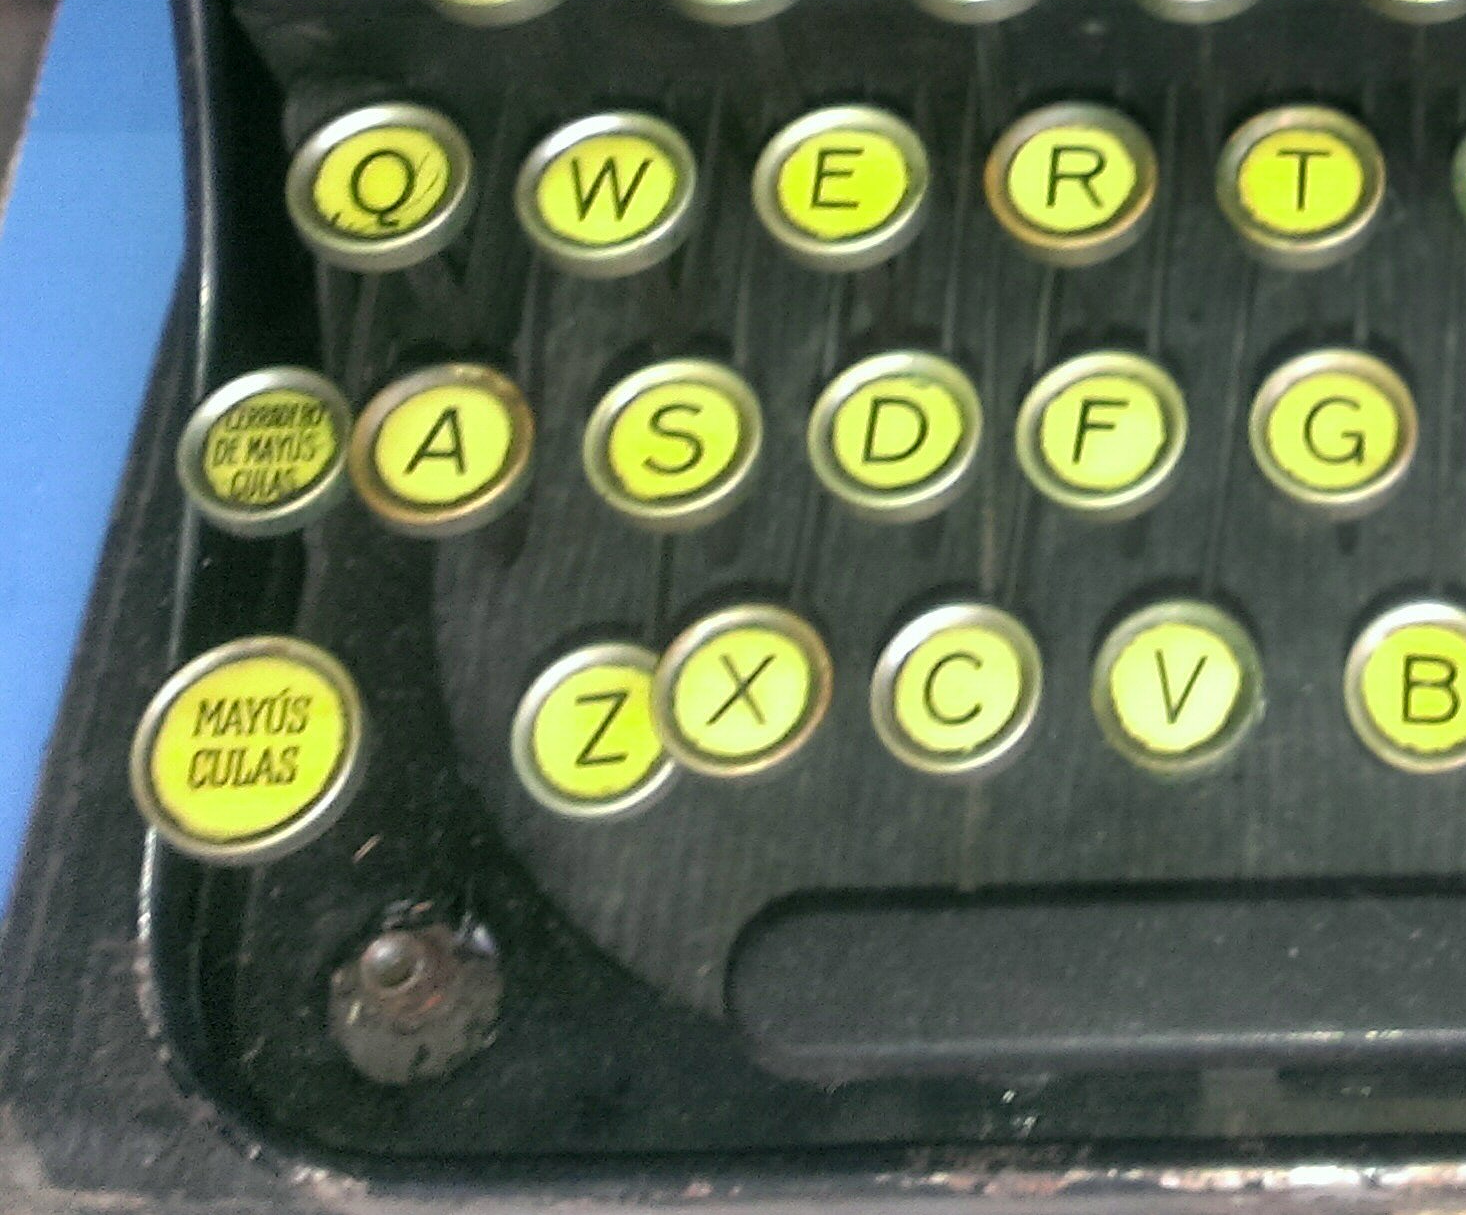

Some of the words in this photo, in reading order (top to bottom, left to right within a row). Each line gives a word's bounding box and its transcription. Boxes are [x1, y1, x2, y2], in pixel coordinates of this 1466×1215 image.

[350, 149, 416, 227] Q
[571, 156, 655, 223] W
[809, 147, 866, 210] E
[1045, 145, 1106, 209] R
[1277, 147, 1332, 212] T
[403, 405, 467, 475] A
[642, 402, 704, 476] S
[862, 396, 929, 465] D
[1071, 398, 1130, 465] F
[1303, 396, 1367, 466] G
[192, 687, 314, 738] MAYÚS
[706, 653, 778, 725] X
[922, 651, 983, 726] C
[1155, 649, 1209, 725] V
[1401, 653, 1462, 725] B
[574, 689, 630, 769] Z
[187, 744, 301, 790] CULAS
